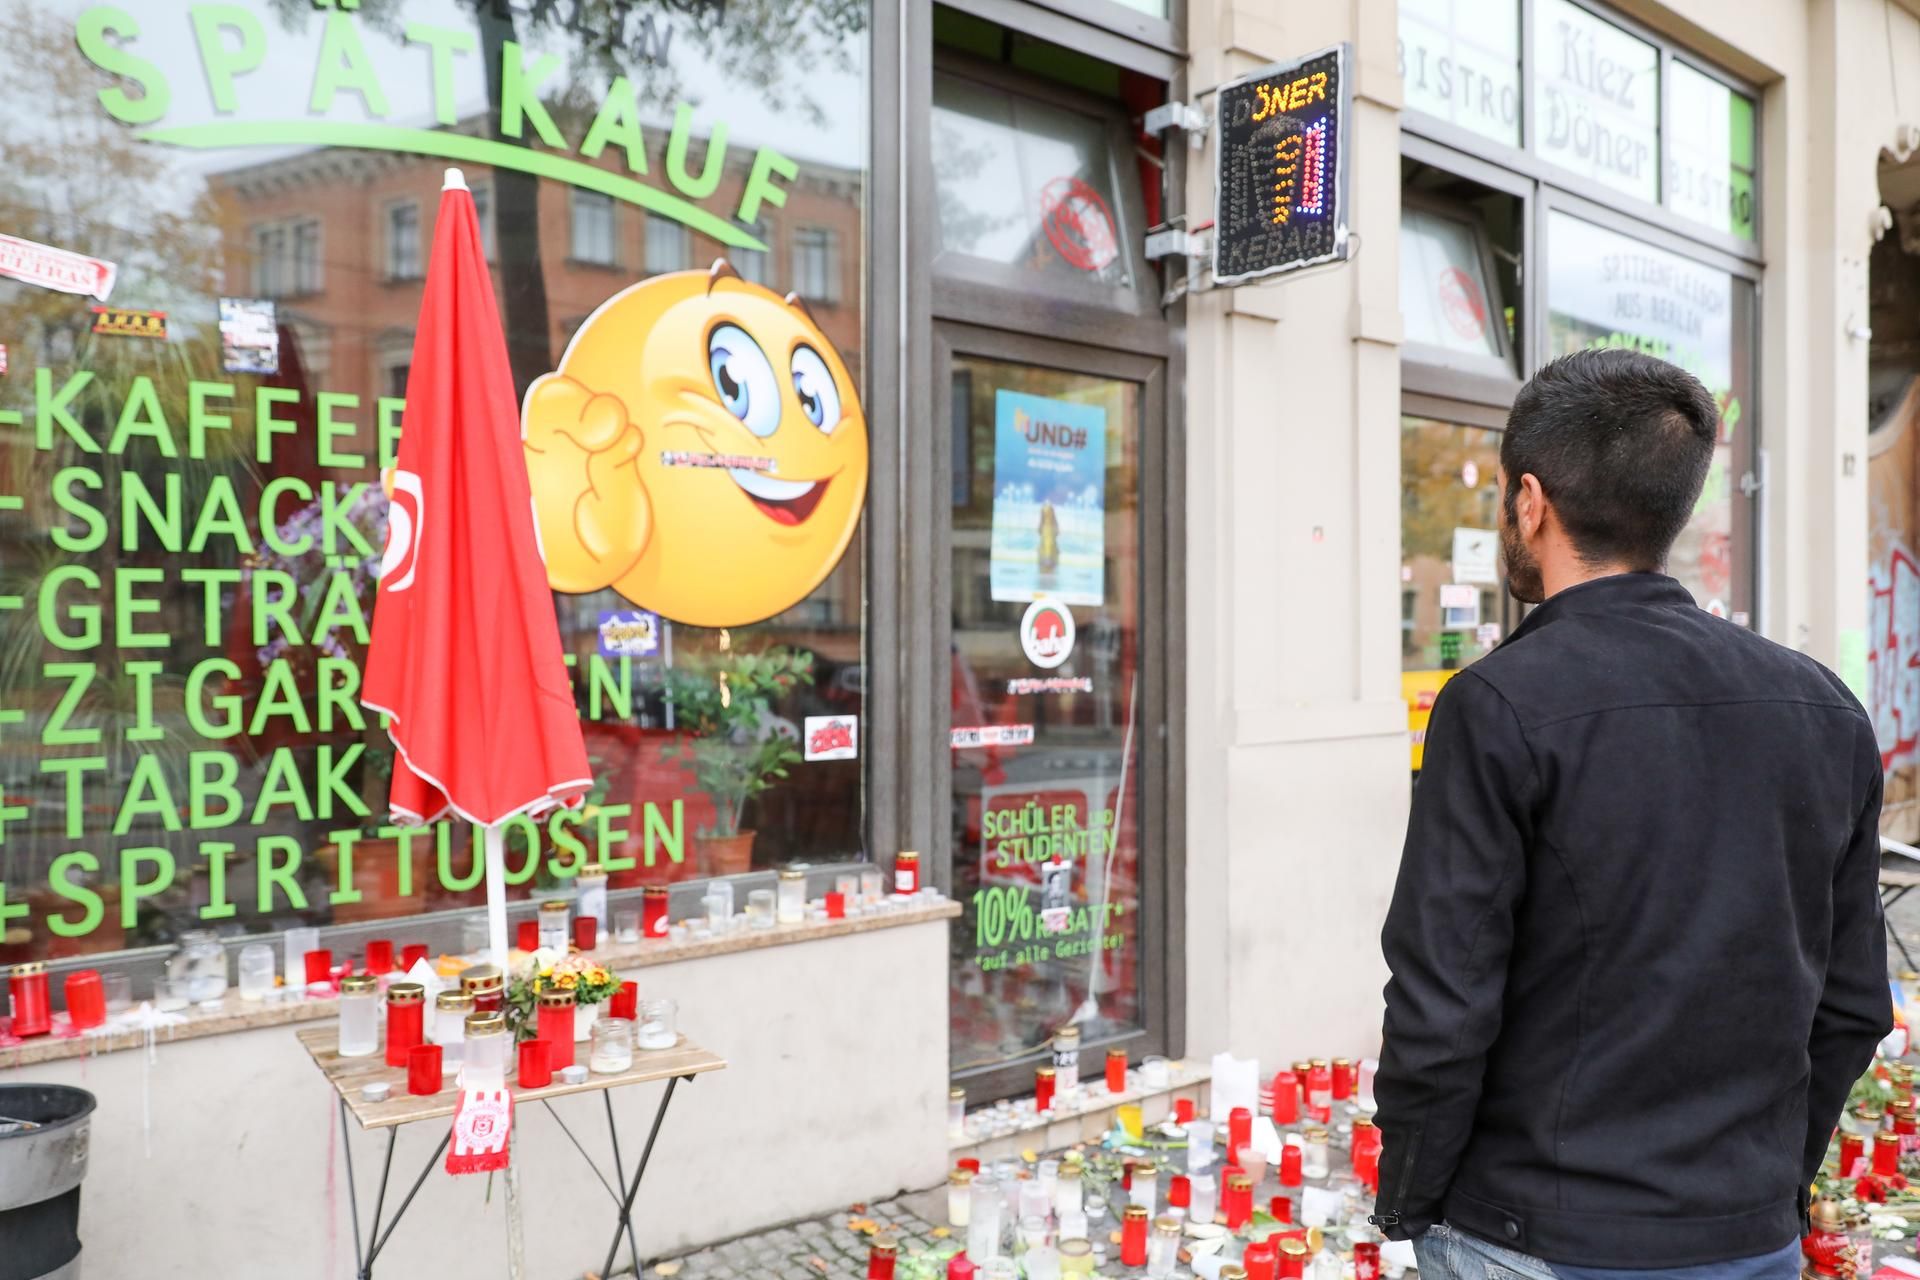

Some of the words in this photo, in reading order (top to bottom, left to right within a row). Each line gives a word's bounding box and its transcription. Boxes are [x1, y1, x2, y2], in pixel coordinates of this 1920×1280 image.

[1230, 71, 1328, 128] DÖNER
[1557, 19, 1637, 110] Kiez
[75, 0, 799, 224] SPÄTKAUF
[1544, 85, 1649, 180] Döner
[40, 743, 371, 839] TABAK
[983, 801, 1078, 839] SCHÜLER
[46, 799, 684, 938] SPIRITUOSEN
[996, 829, 1115, 869] STUDENTEN
[973, 886, 1034, 947] 10%
[1015, 945, 1050, 966] alle
